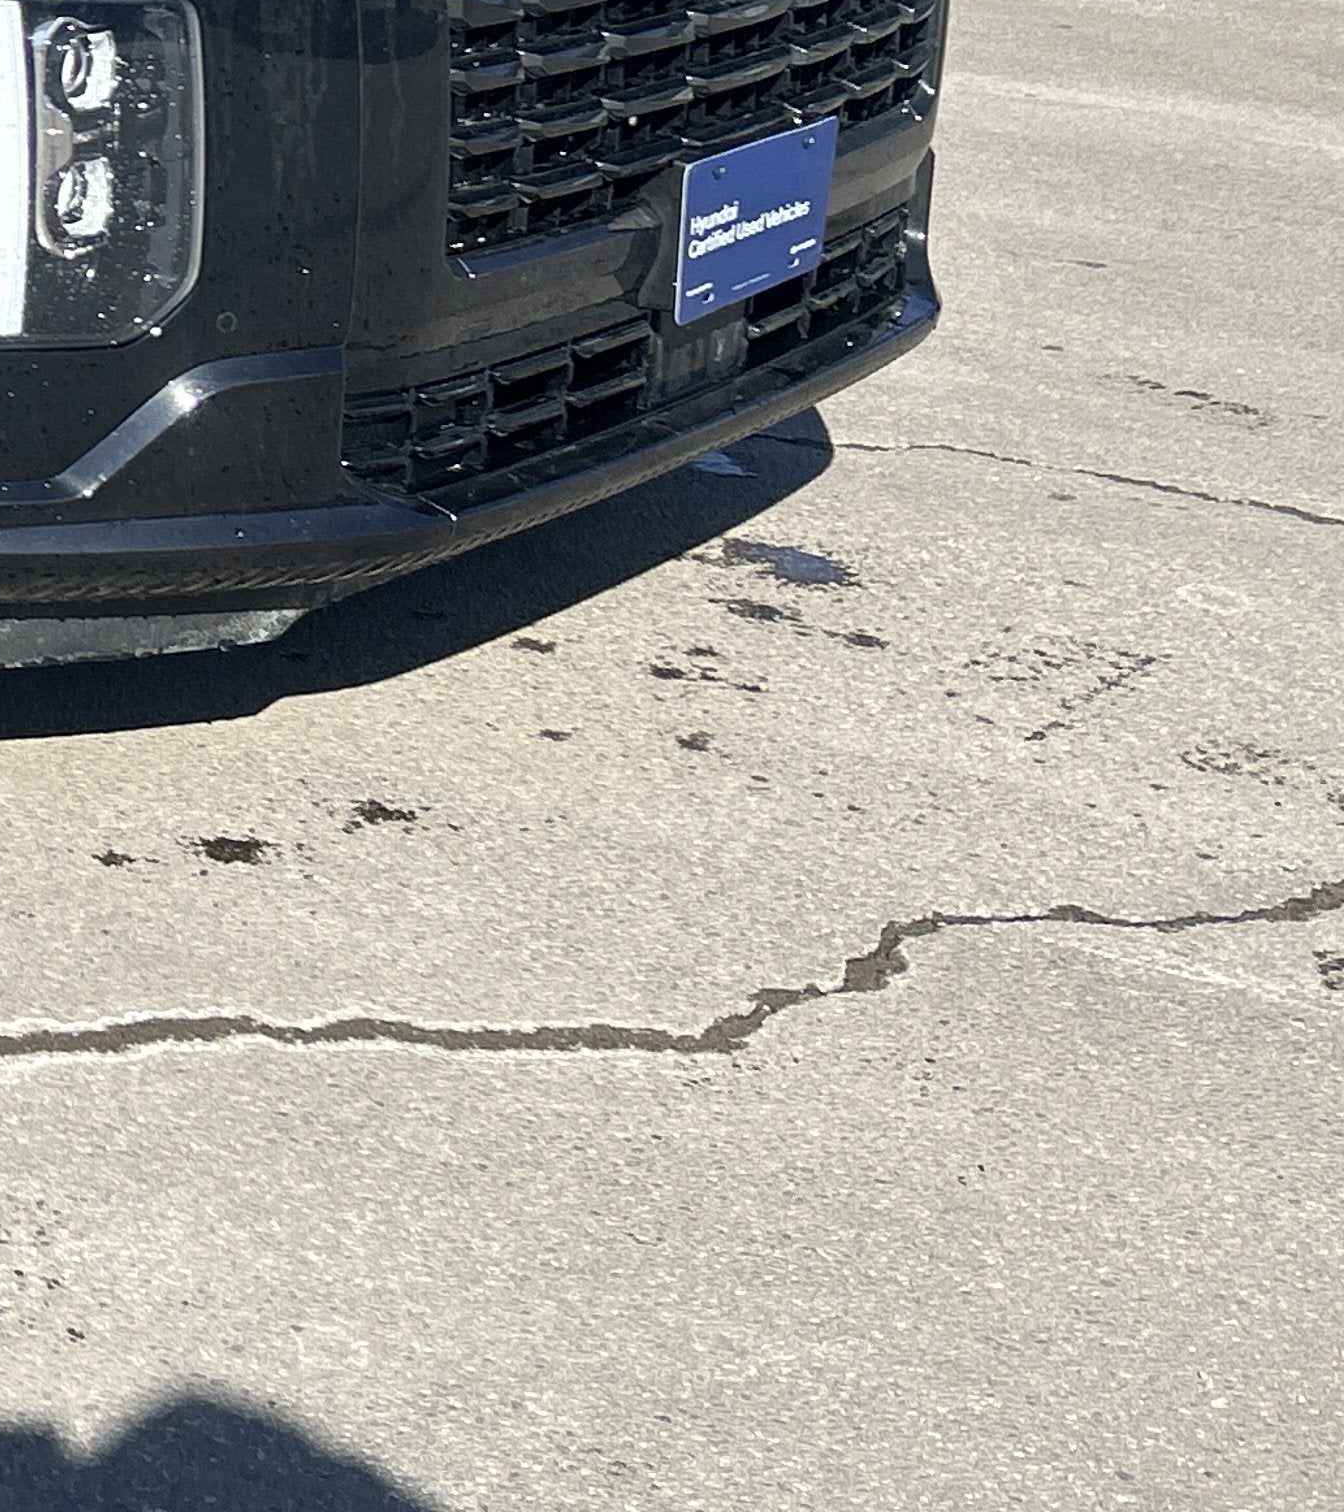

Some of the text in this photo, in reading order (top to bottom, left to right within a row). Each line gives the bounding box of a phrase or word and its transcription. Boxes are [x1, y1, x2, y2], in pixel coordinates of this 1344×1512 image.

[688, 201, 810, 259] Certified Used Vehicles
[690, 200, 739, 236] Hyundai
